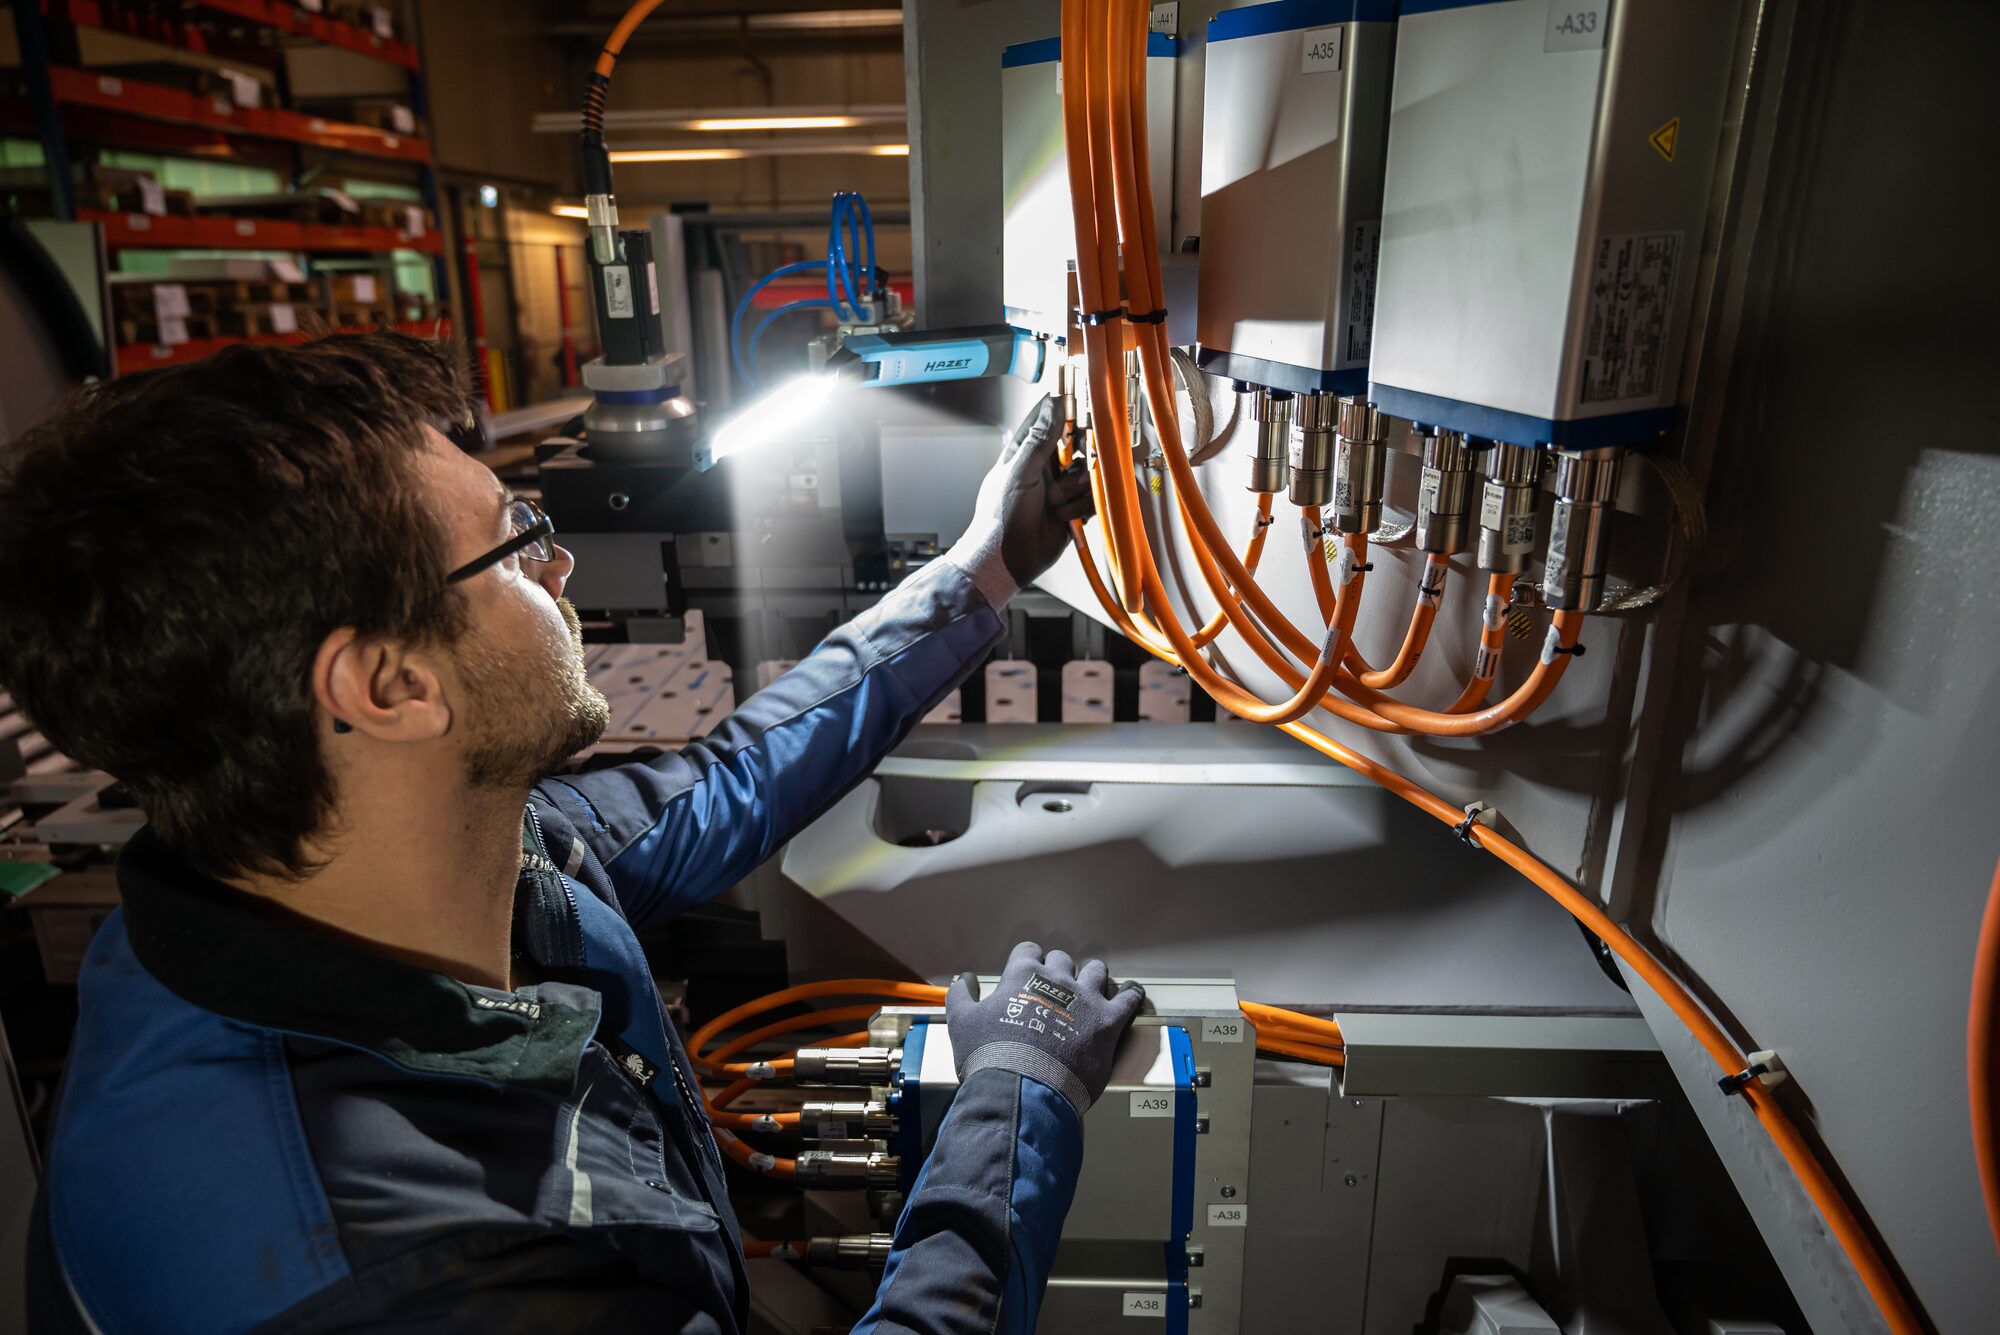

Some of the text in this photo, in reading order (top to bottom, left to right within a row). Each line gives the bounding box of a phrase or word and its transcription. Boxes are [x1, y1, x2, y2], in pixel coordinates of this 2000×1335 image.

[1157, 13, 1174, 25] -A41
[1555, 11, 1597, 35] -A33
[1307, 42, 1334, 60] -A35
[924, 358, 973, 373] HAZET
[1029, 978, 1073, 1002] HAZET
[1208, 1025, 1238, 1036] -A39
[1137, 1099, 1168, 1110] -A39
[1212, 1211, 1241, 1220] -A38
[1129, 1300, 1159, 1310] -A38
